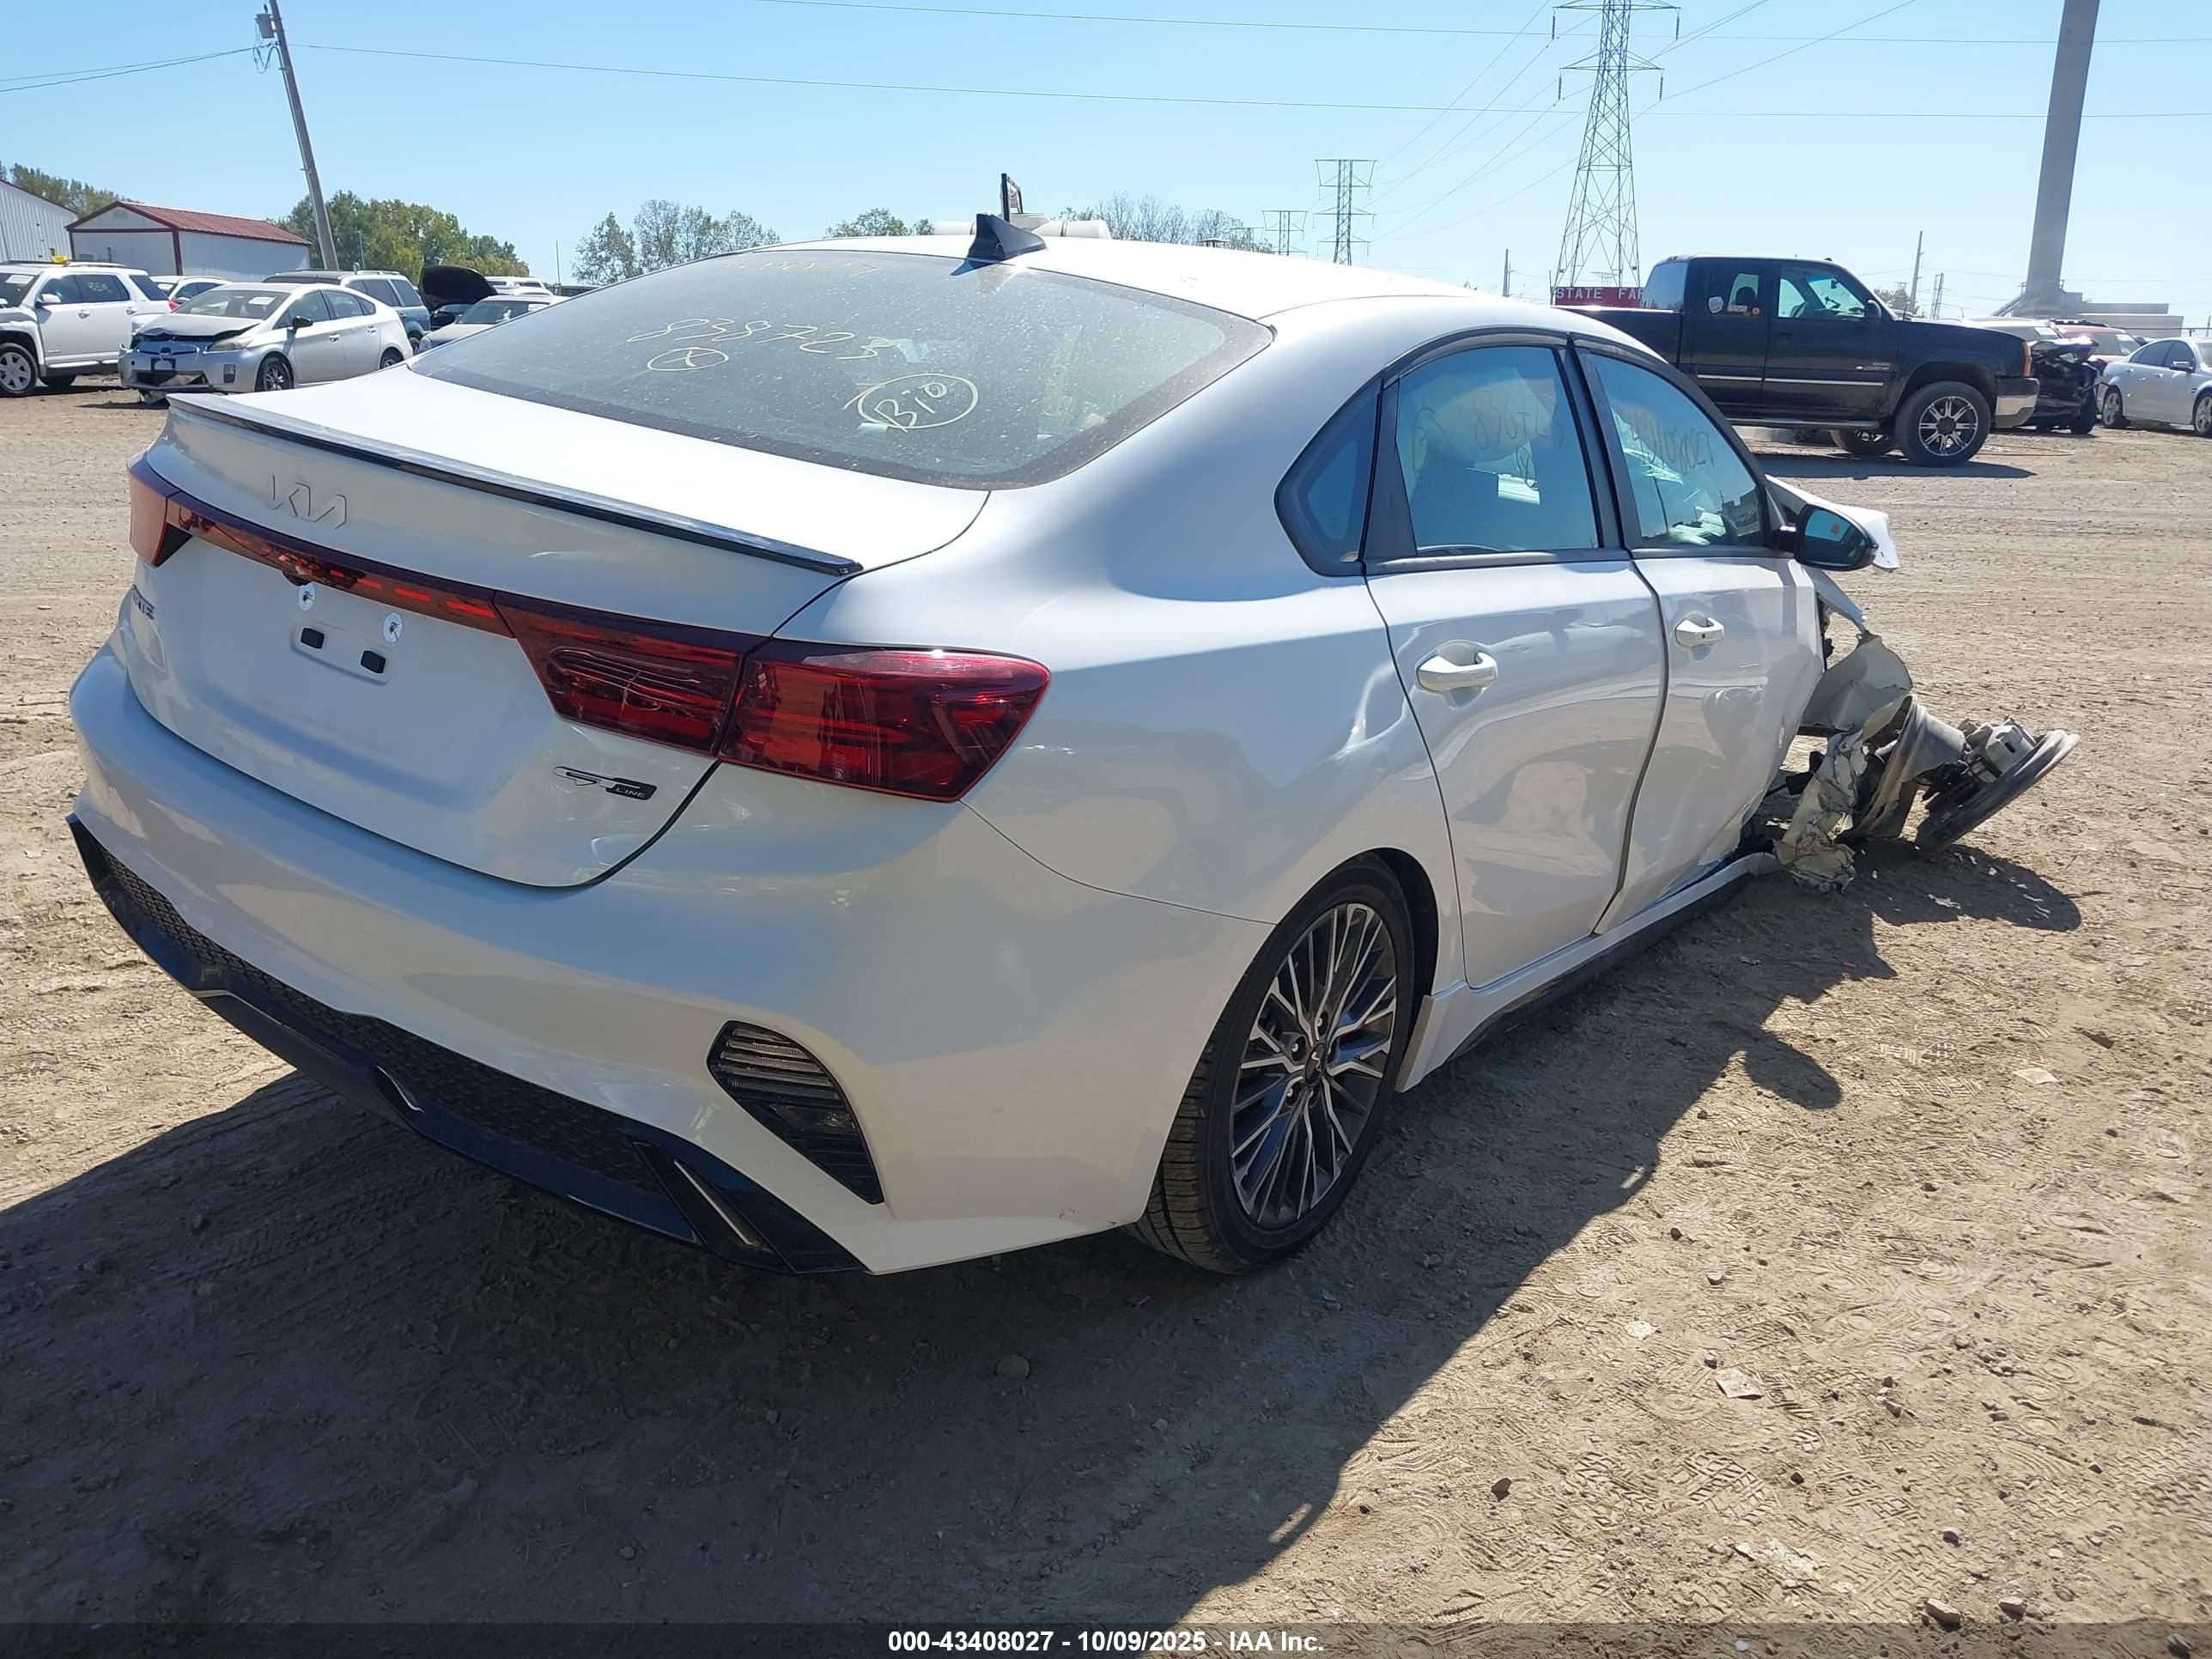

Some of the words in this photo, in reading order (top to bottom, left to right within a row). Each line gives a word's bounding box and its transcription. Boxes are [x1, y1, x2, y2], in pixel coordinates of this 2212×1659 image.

[1556, 287, 1603, 299] STATE
[268, 474, 348, 530] KIA
[615, 787, 647, 799] LINE
